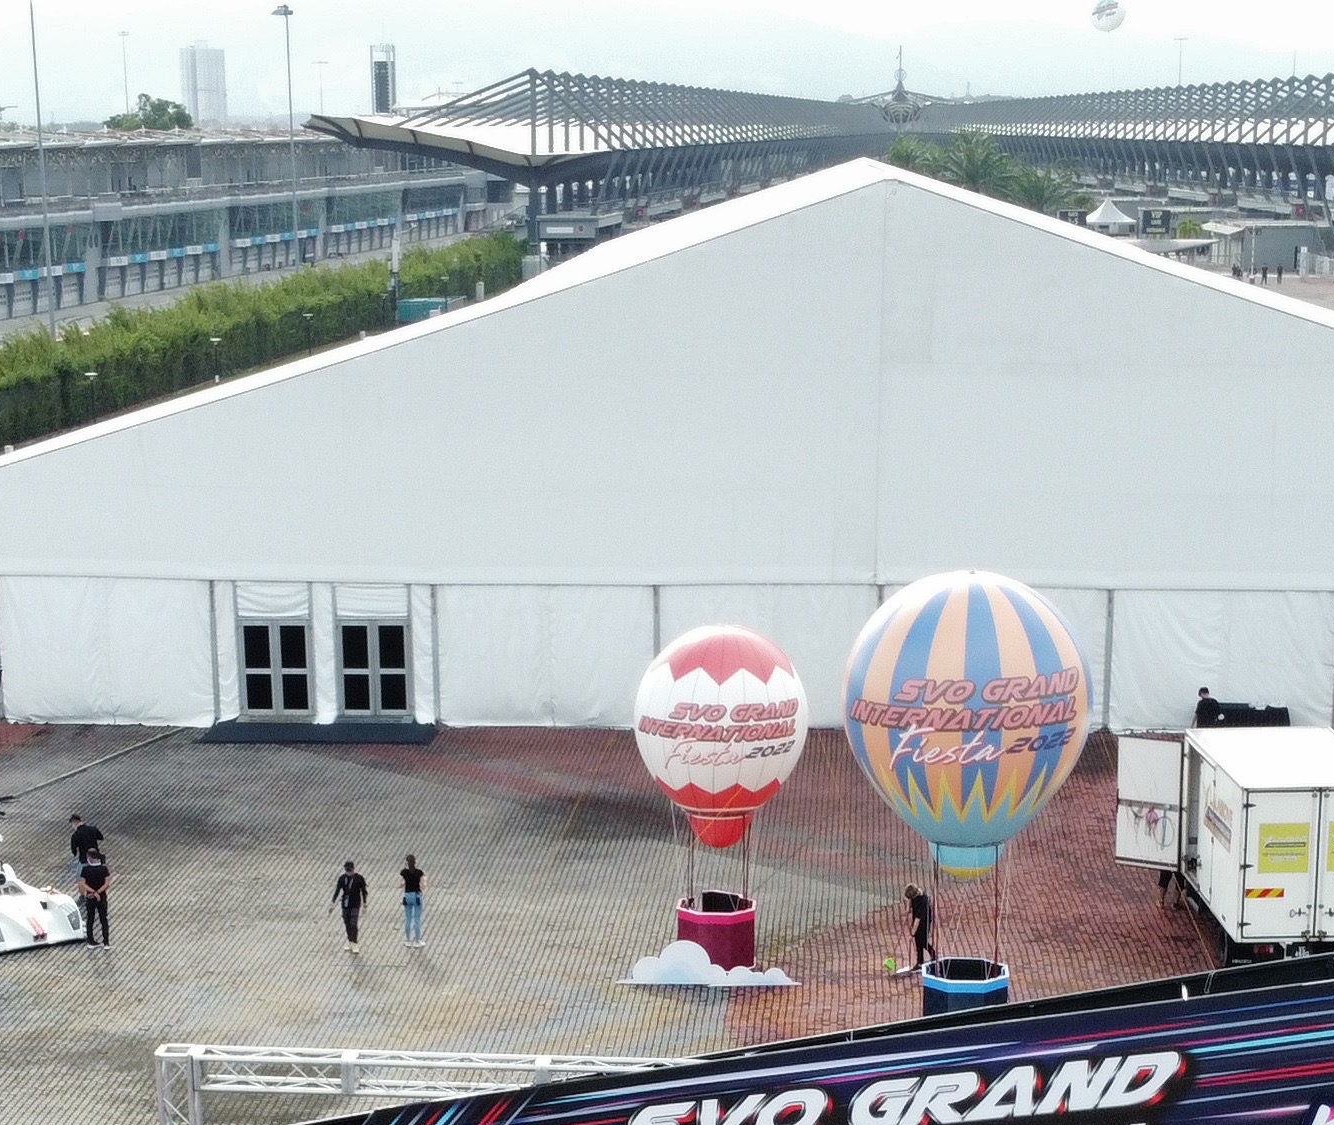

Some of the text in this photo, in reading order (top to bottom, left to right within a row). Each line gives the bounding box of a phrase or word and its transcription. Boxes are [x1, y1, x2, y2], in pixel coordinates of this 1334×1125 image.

[894, 666, 1079, 704] SVO GRAND
[668, 697, 799, 723] SVO GRAND
[850, 698, 1078, 732] INTERNATIONAL
[639, 715, 796, 743] INTERNATIONAL
[665, 738, 796, 769] Fiesta 2022
[889, 723, 1075, 772] Fiesta 2022
